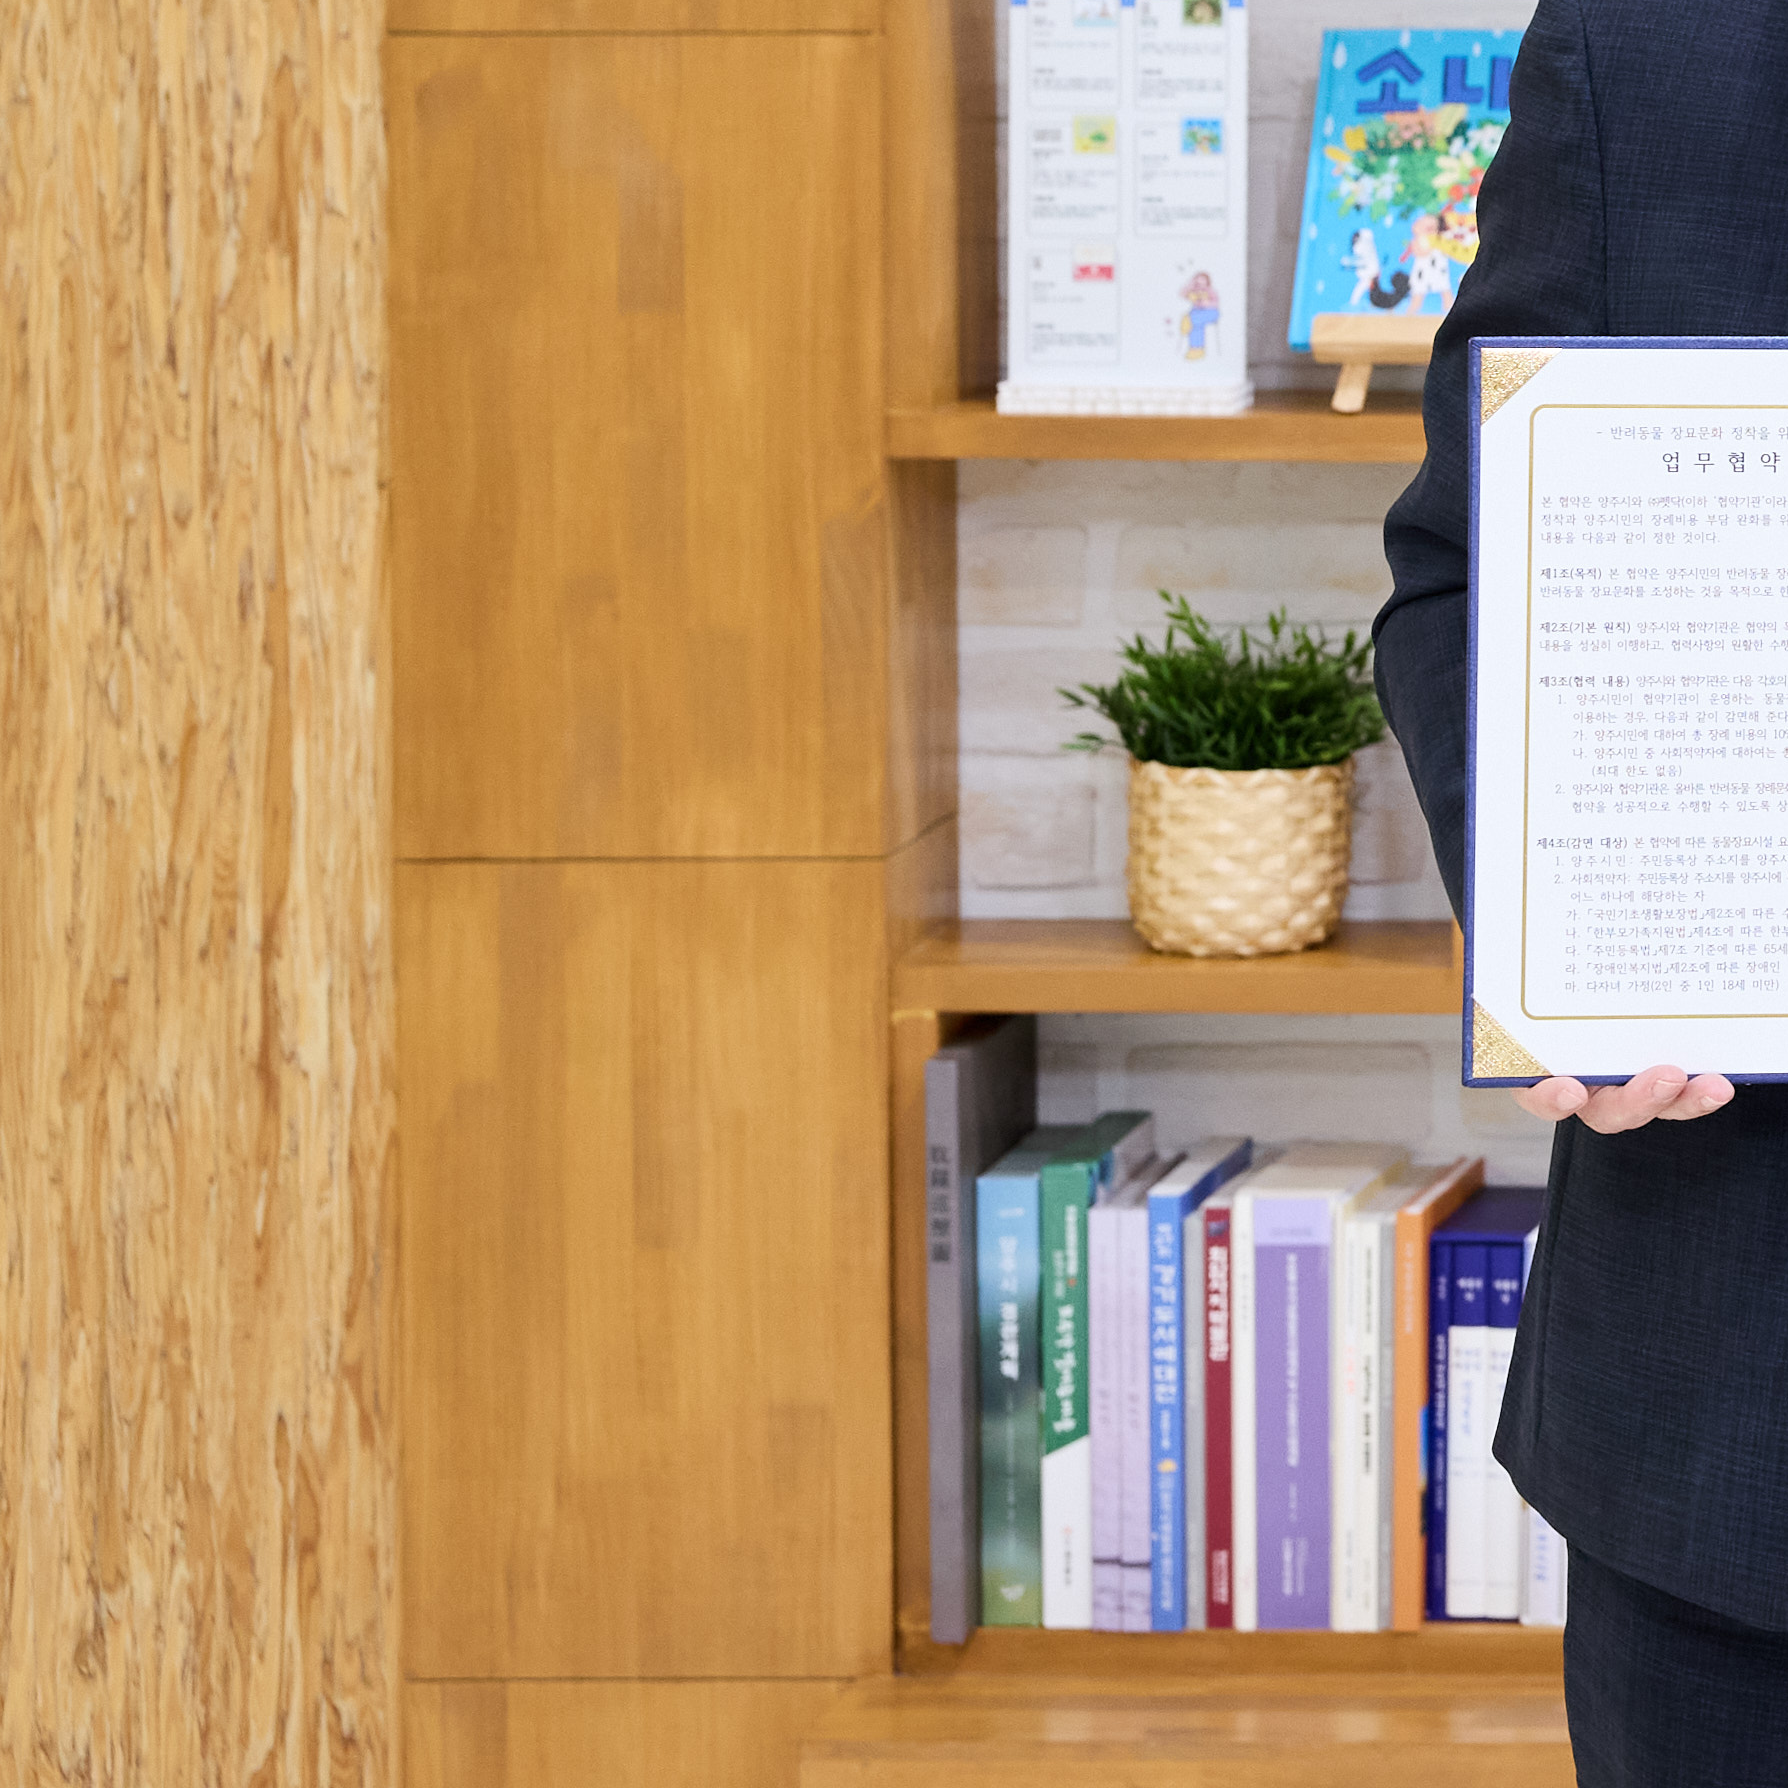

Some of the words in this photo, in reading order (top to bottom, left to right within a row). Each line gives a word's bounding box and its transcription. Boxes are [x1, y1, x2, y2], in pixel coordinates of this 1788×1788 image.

[1610, 425, 1664, 441] 반려동물
[1670, 425, 1724, 441] 장묘문화
[1730, 425, 1771, 441] 정착을
[1541, 495, 1553, 509] 본
[1558, 495, 1593, 509] 협약은
[1597, 495, 1643, 509] 양주시와
[1540, 513, 1577, 527] 정착과
[1583, 513, 1644, 527] 양주시민의
[1651, 513, 1699, 527] 장례비용
[1705, 513, 1730, 527] 부담
[1736, 513, 1772, 527] 완화를
[1540, 531, 1576, 545] 내용을
[1581, 531, 1617, 545] 다음과
[1623, 531, 1646, 545] 같이
[1653, 531, 1676, 545] 정한
[1608, 567, 1620, 580] 본
[1626, 567, 1661, 581] 협약은
[1665, 567, 1721, 581] 양주시민의
[1726, 567, 1771, 581] 반려동물
[1539, 585, 1585, 599] 반려동물
[1589, 585, 1646, 598] 장묘문화를
[1650, 585, 1696, 599] 조성하는
[1700, 585, 1723, 598] 것을
[1729, 585, 1774, 598] 목적으로
